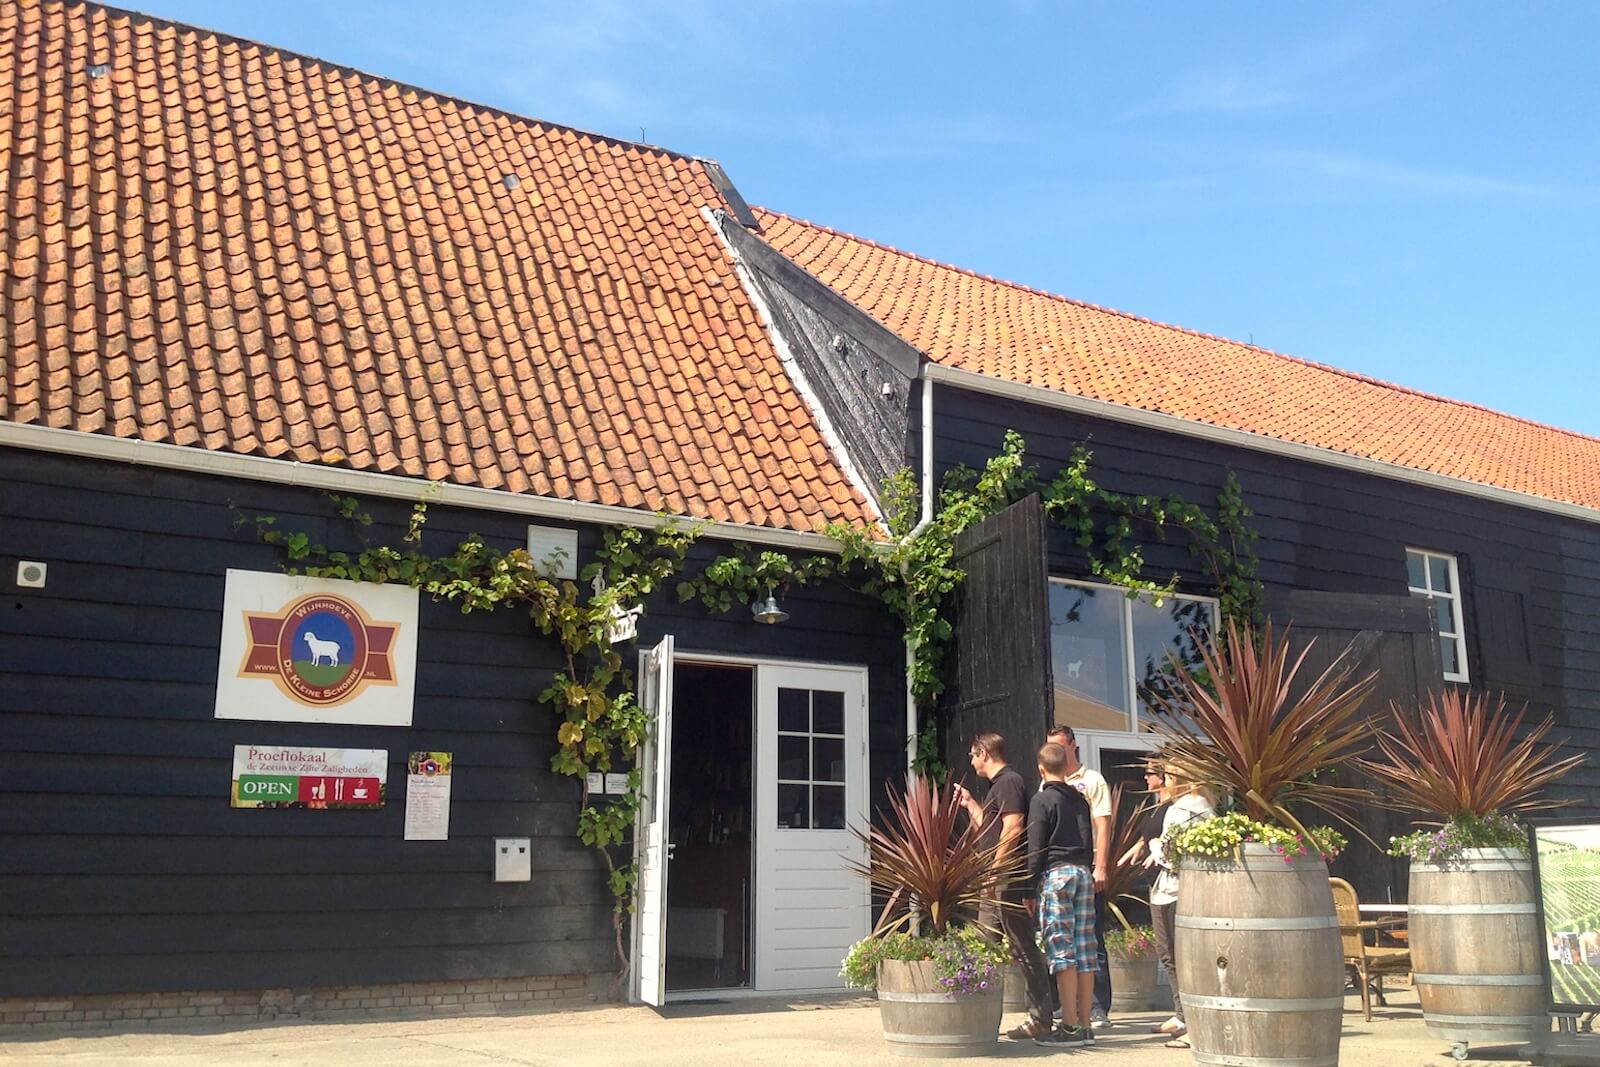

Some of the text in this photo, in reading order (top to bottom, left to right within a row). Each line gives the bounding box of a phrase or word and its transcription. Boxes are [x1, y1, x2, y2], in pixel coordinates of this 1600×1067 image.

[283, 659, 293, 675] DE
[290, 674, 321, 698] KLEINE
[248, 749, 326, 763] Proeflokaal
[321, 764, 368, 775] Zaligheden
[243, 781, 293, 795] OPEN
